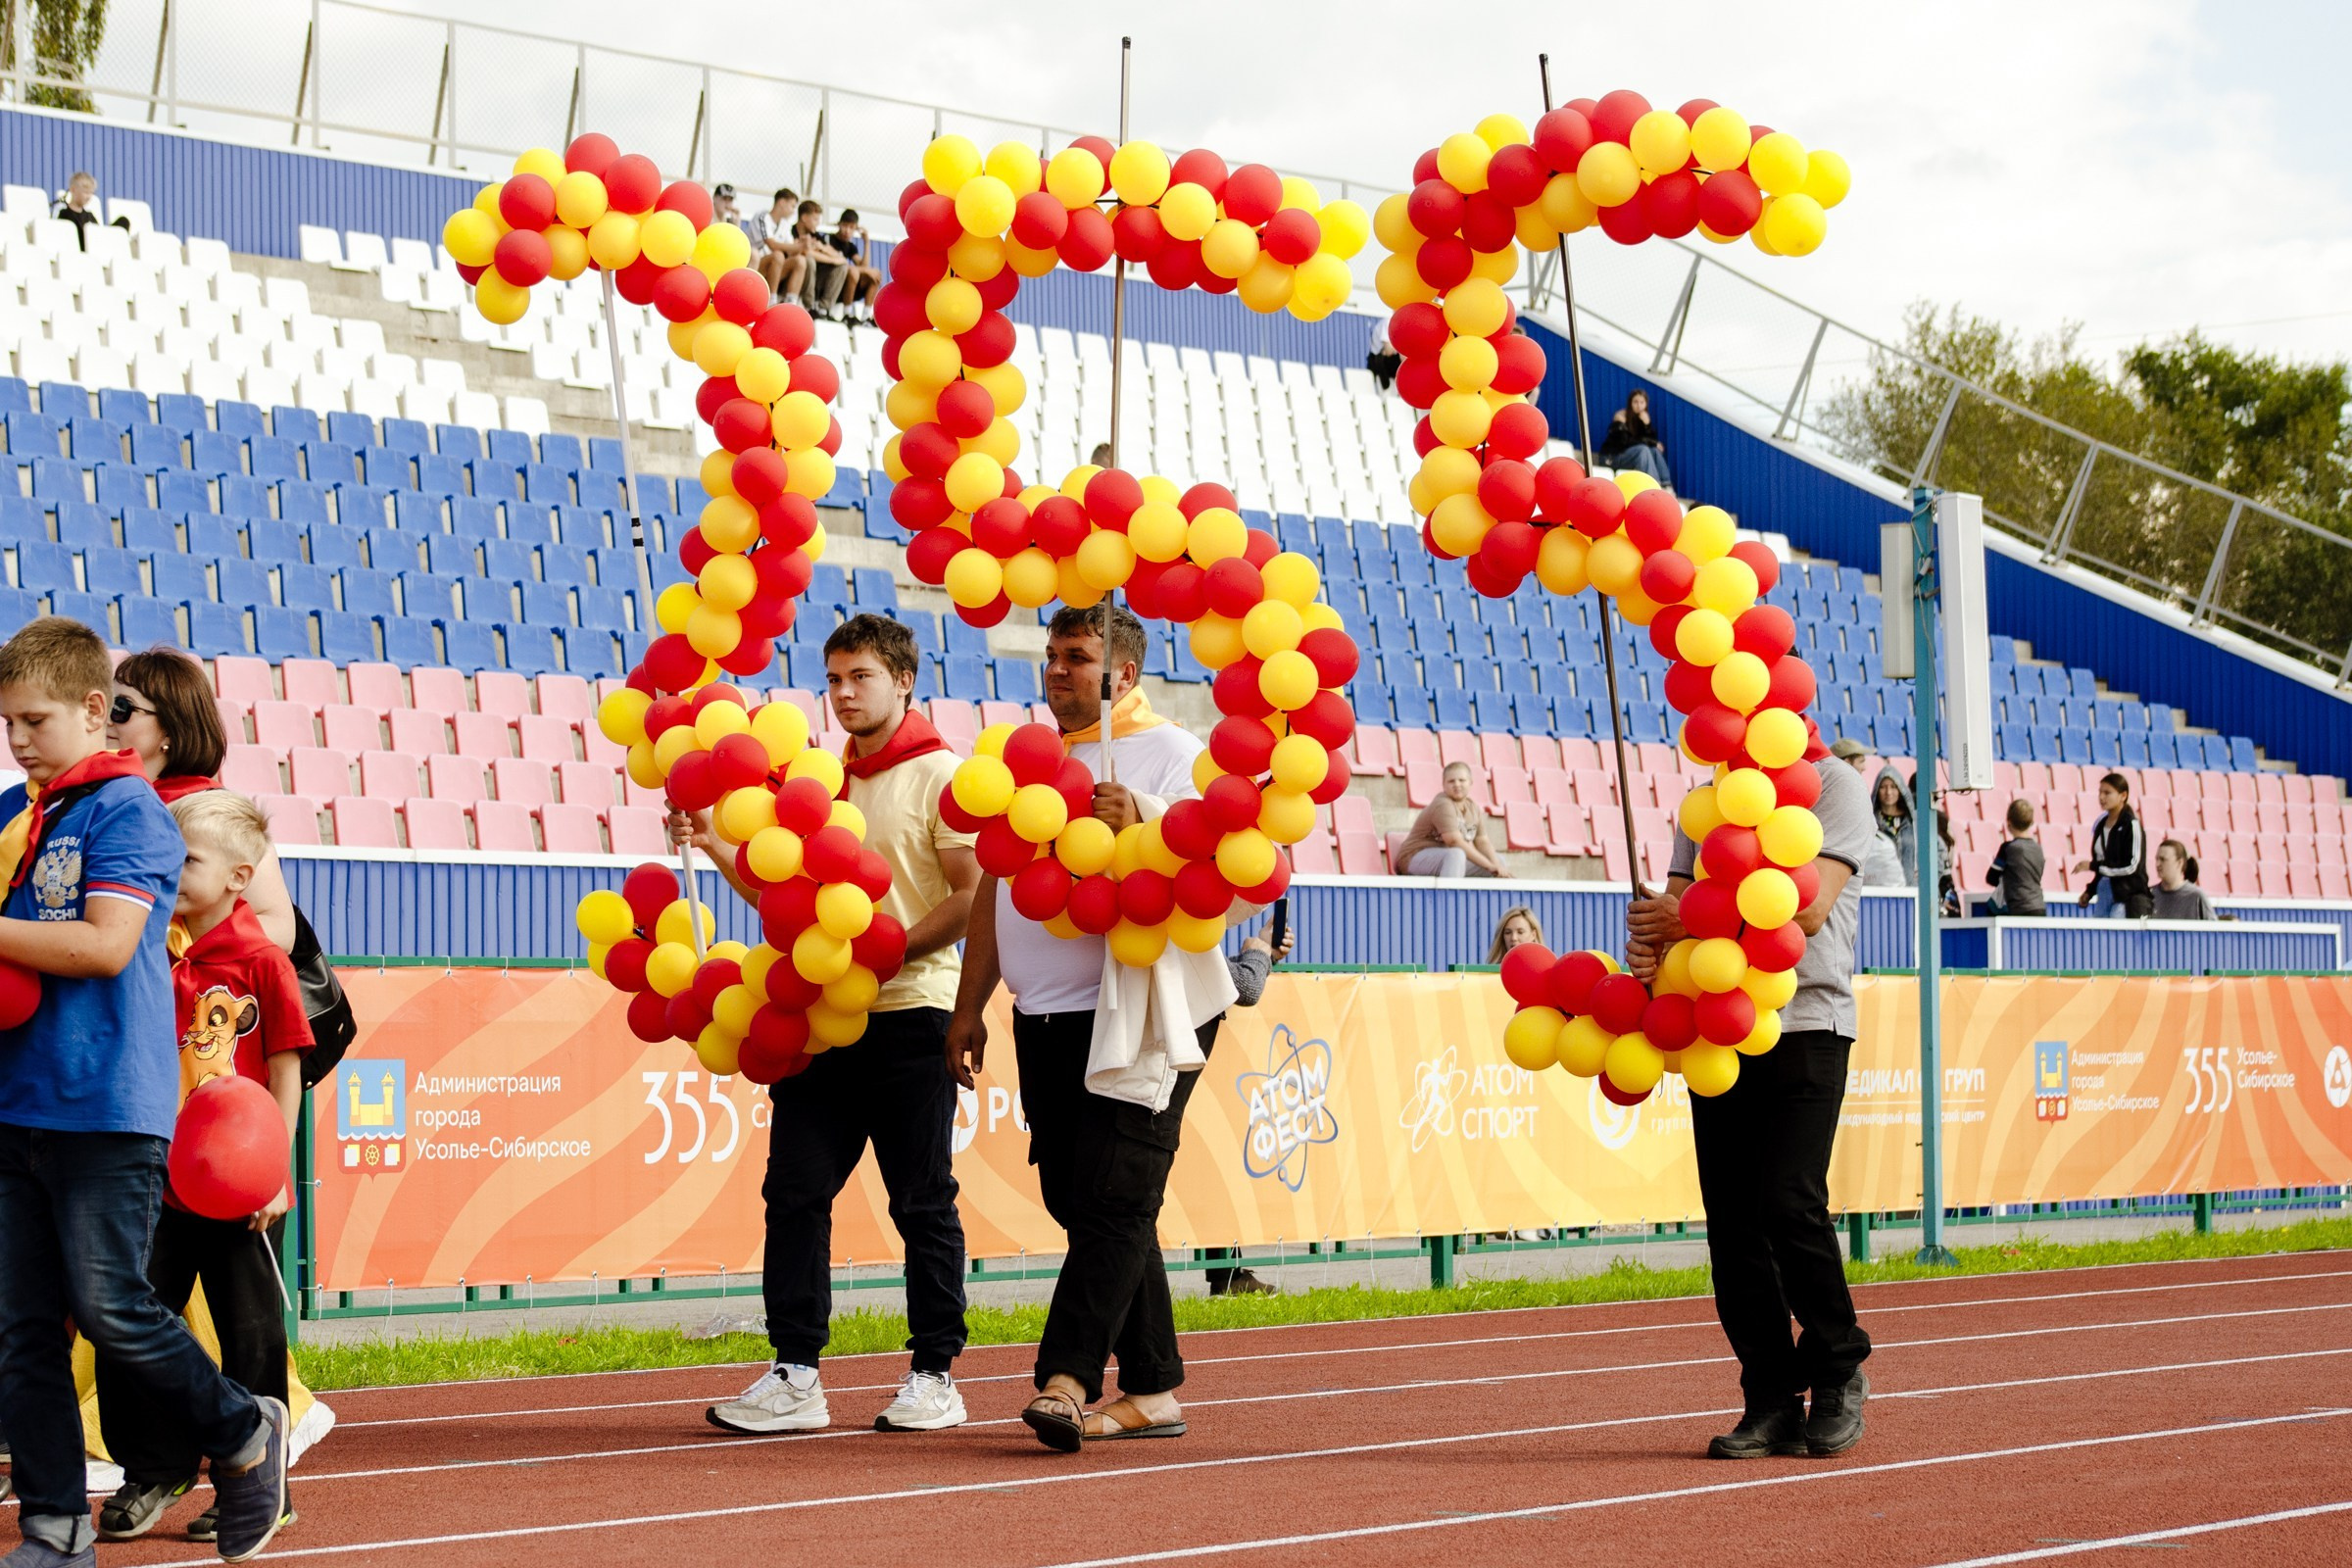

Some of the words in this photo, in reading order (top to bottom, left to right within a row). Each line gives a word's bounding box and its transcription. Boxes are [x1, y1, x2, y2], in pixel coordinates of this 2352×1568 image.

[38, 907, 77, 921] SOCHI
[2071, 1049, 2144, 1068] Администрация
[2236, 1047, 2278, 1066] Усолье-
[415, 1071, 562, 1098] Администрация
[1250, 1056, 1325, 1129] АТОМ
[1470, 1064, 1534, 1097] АТОМ
[1844, 1068, 1914, 1098] ЕДИКАЛ
[1944, 1068, 1985, 1093] ГРУП
[2072, 1075, 2105, 1092] города
[2183, 1047, 2233, 1114] 355
[2237, 1069, 2295, 1091] Сибирское
[2072, 1094, 2160, 1112] Усолье-Сибирское
[416, 1109, 481, 1132] города
[642, 1070, 740, 1164] 355
[1253, 1094, 1325, 1161] ФЕСТ
[1461, 1106, 1540, 1140] СПОРТ
[415, 1136, 591, 1162] Усолье-Сибирское
